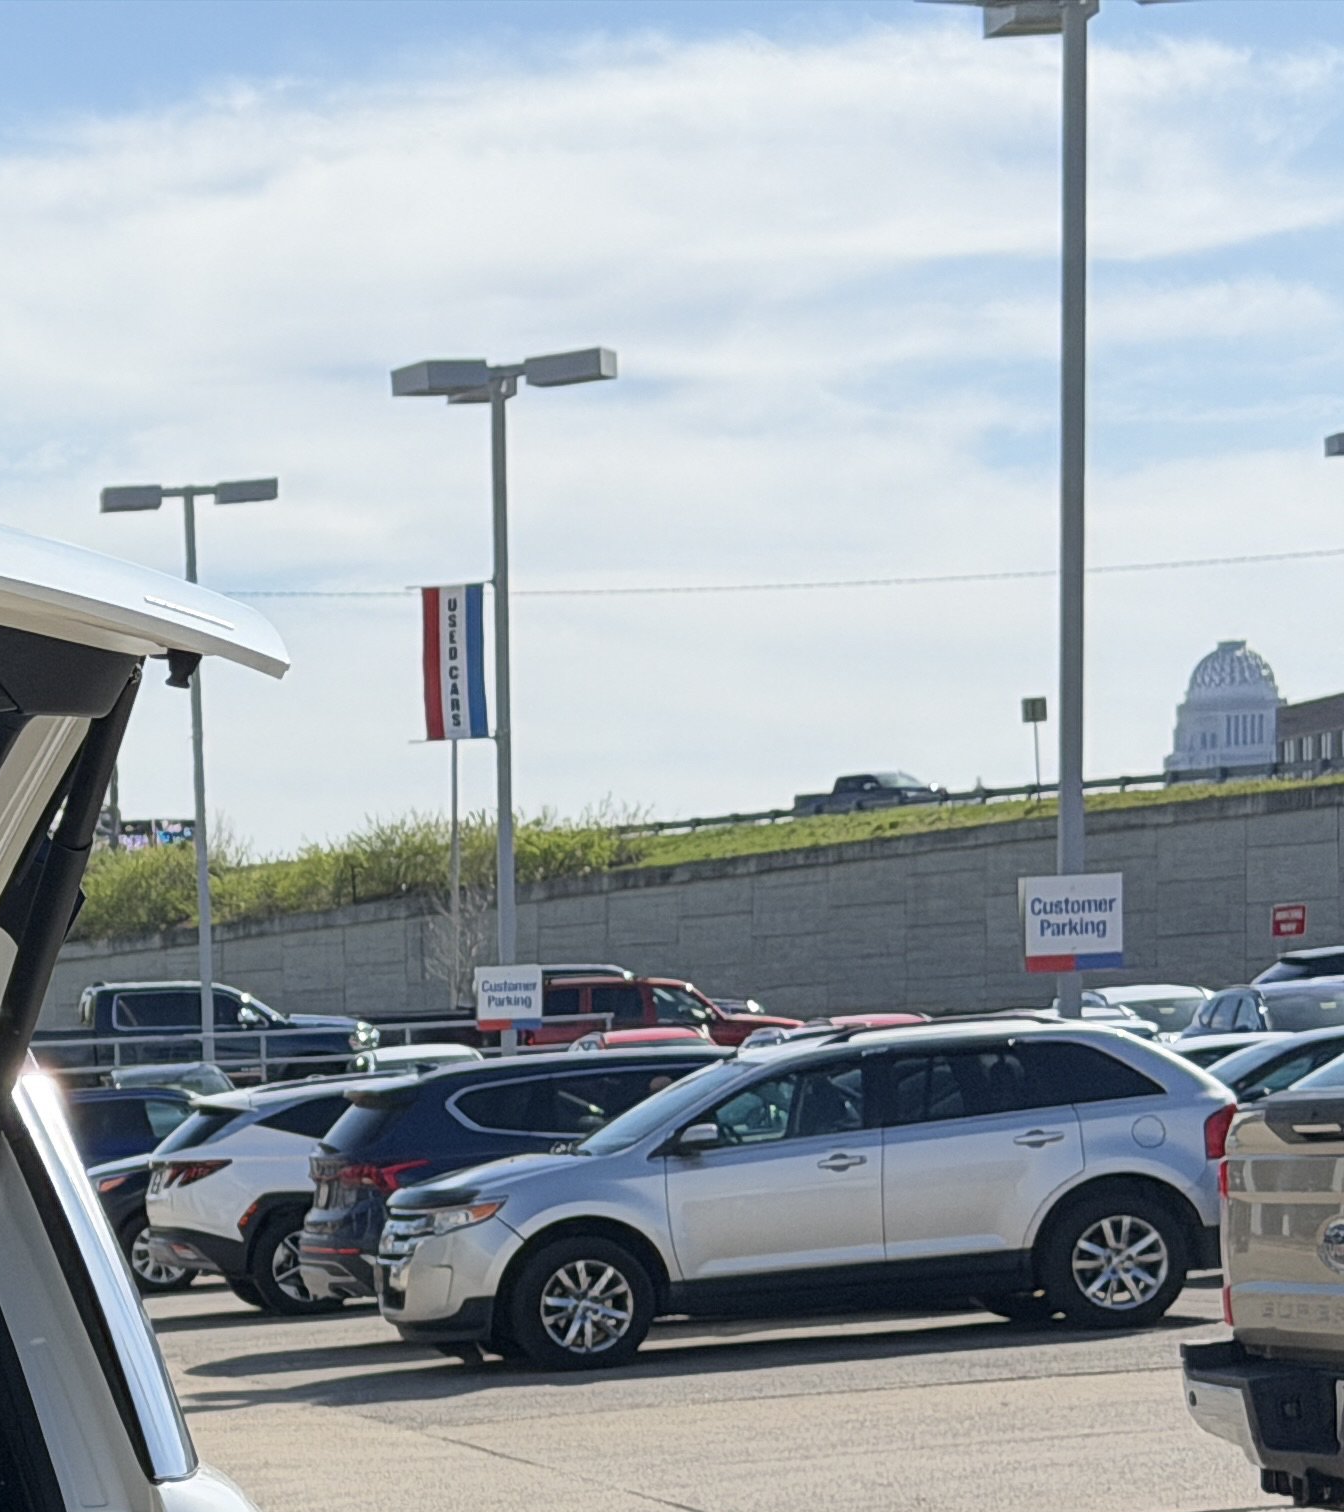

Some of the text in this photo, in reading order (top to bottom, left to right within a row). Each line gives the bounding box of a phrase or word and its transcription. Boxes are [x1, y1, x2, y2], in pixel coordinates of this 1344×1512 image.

[447, 598, 461, 727] USED CARS
[1030, 896, 1117, 916] Customer
[1039, 917, 1107, 938] Parking
[481, 979, 538, 993] Customer
[487, 994, 533, 1009] Parking
